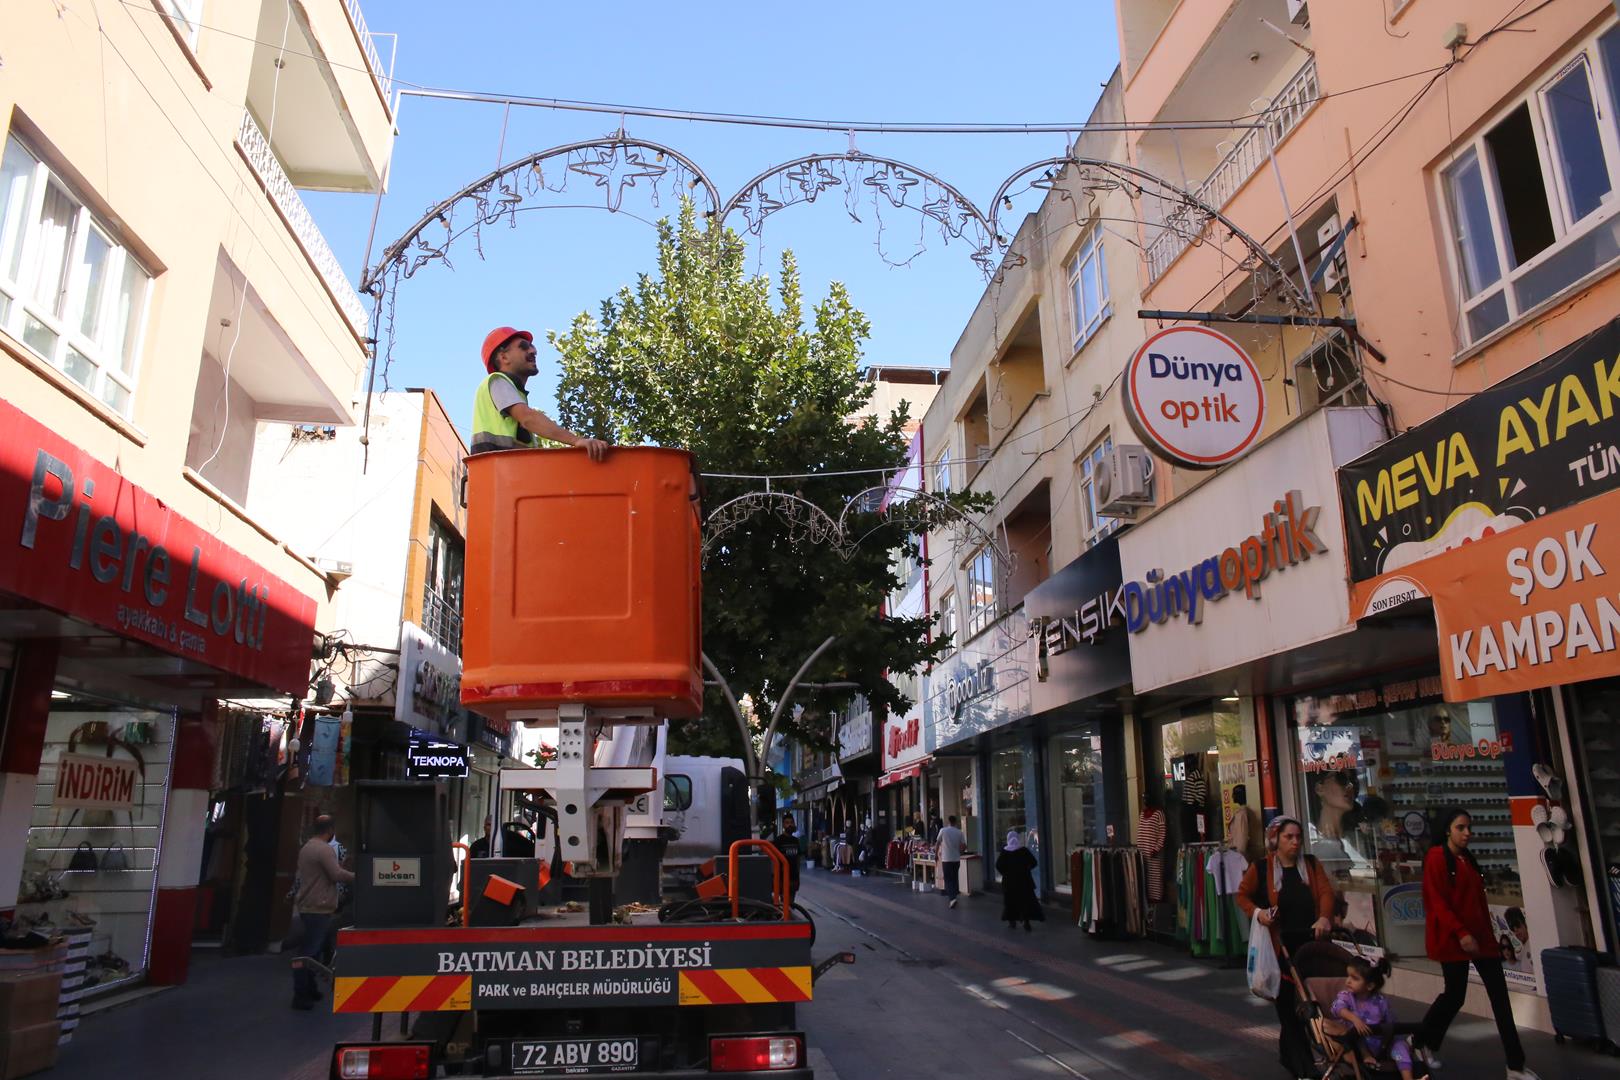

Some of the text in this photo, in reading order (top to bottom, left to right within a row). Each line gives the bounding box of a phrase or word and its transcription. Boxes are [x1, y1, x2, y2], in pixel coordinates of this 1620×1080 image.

[1148, 353, 1242, 387] Dünya
[1160, 392, 1240, 428] optik
[1356, 431, 1480, 527] MEVA
[20, 448, 269, 652] Piere Lotti
[1506, 522, 1606, 605] ŞOK
[1372, 589, 1417, 612] SON FIRSAT
[412, 755, 465, 767] TEKNOPA
[1431, 742, 1475, 762] Dünya
[57, 759, 135, 802] İNDİRİM
[378, 871, 416, 880] baksan
[437, 941, 712, 973] BATMAN BELEDİYESİ
[478, 977, 672, 999] PARK ve BAHÇELER MÜDÜRLÜĞÜ
[522, 1041, 635, 1065] 72 ABV 890
